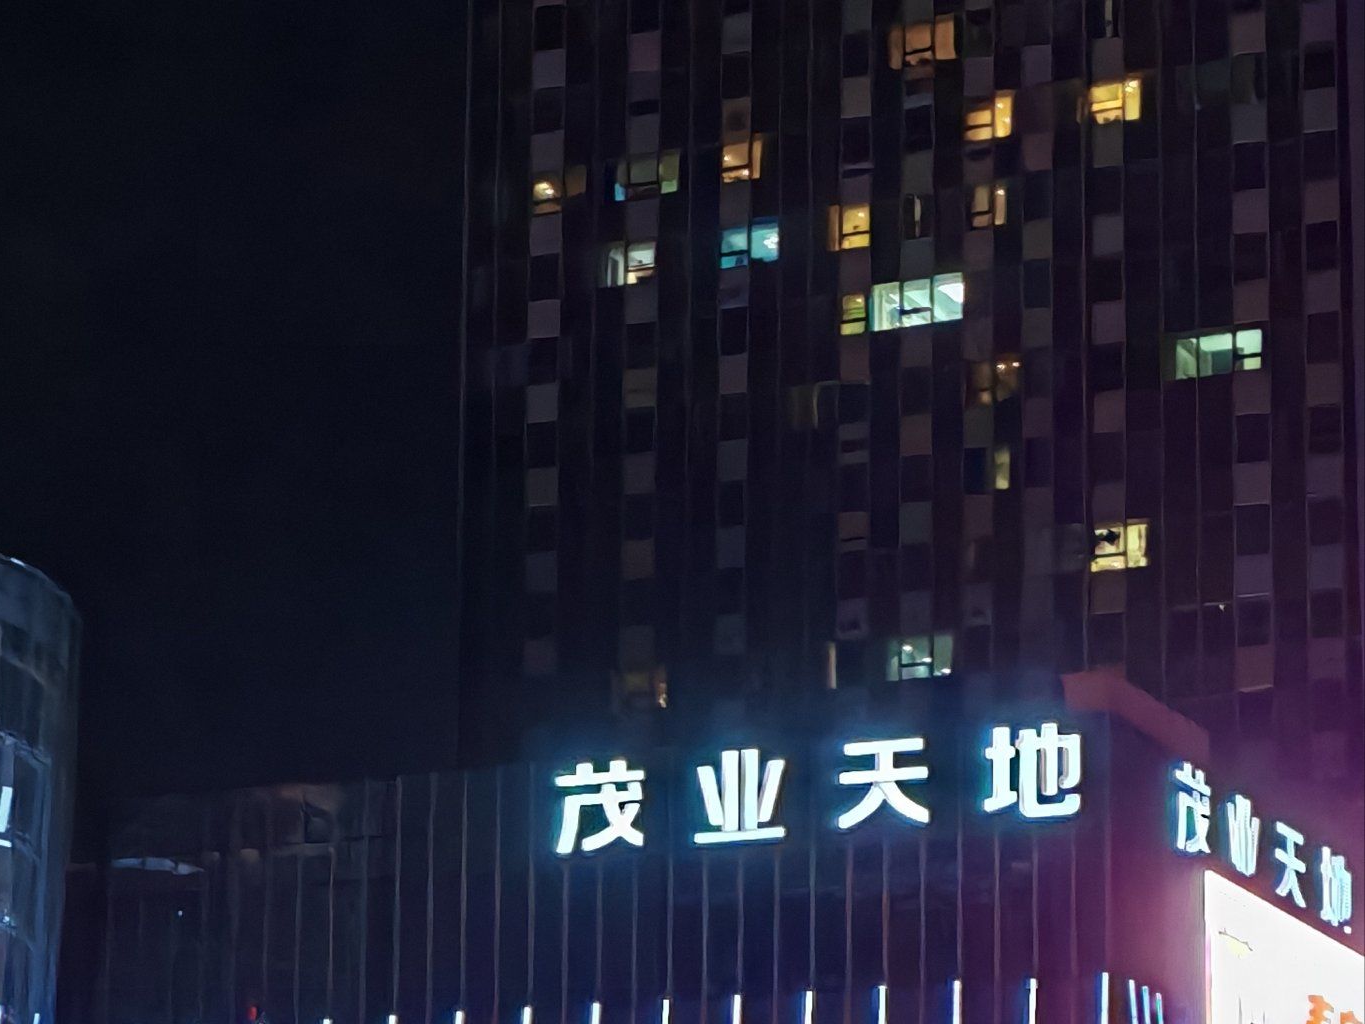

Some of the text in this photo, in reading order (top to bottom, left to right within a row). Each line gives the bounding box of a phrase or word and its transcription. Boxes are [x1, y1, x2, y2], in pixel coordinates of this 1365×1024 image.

[554, 722, 1082, 856] 茂业天地
[1174, 760, 1353, 928] 茂业天地
